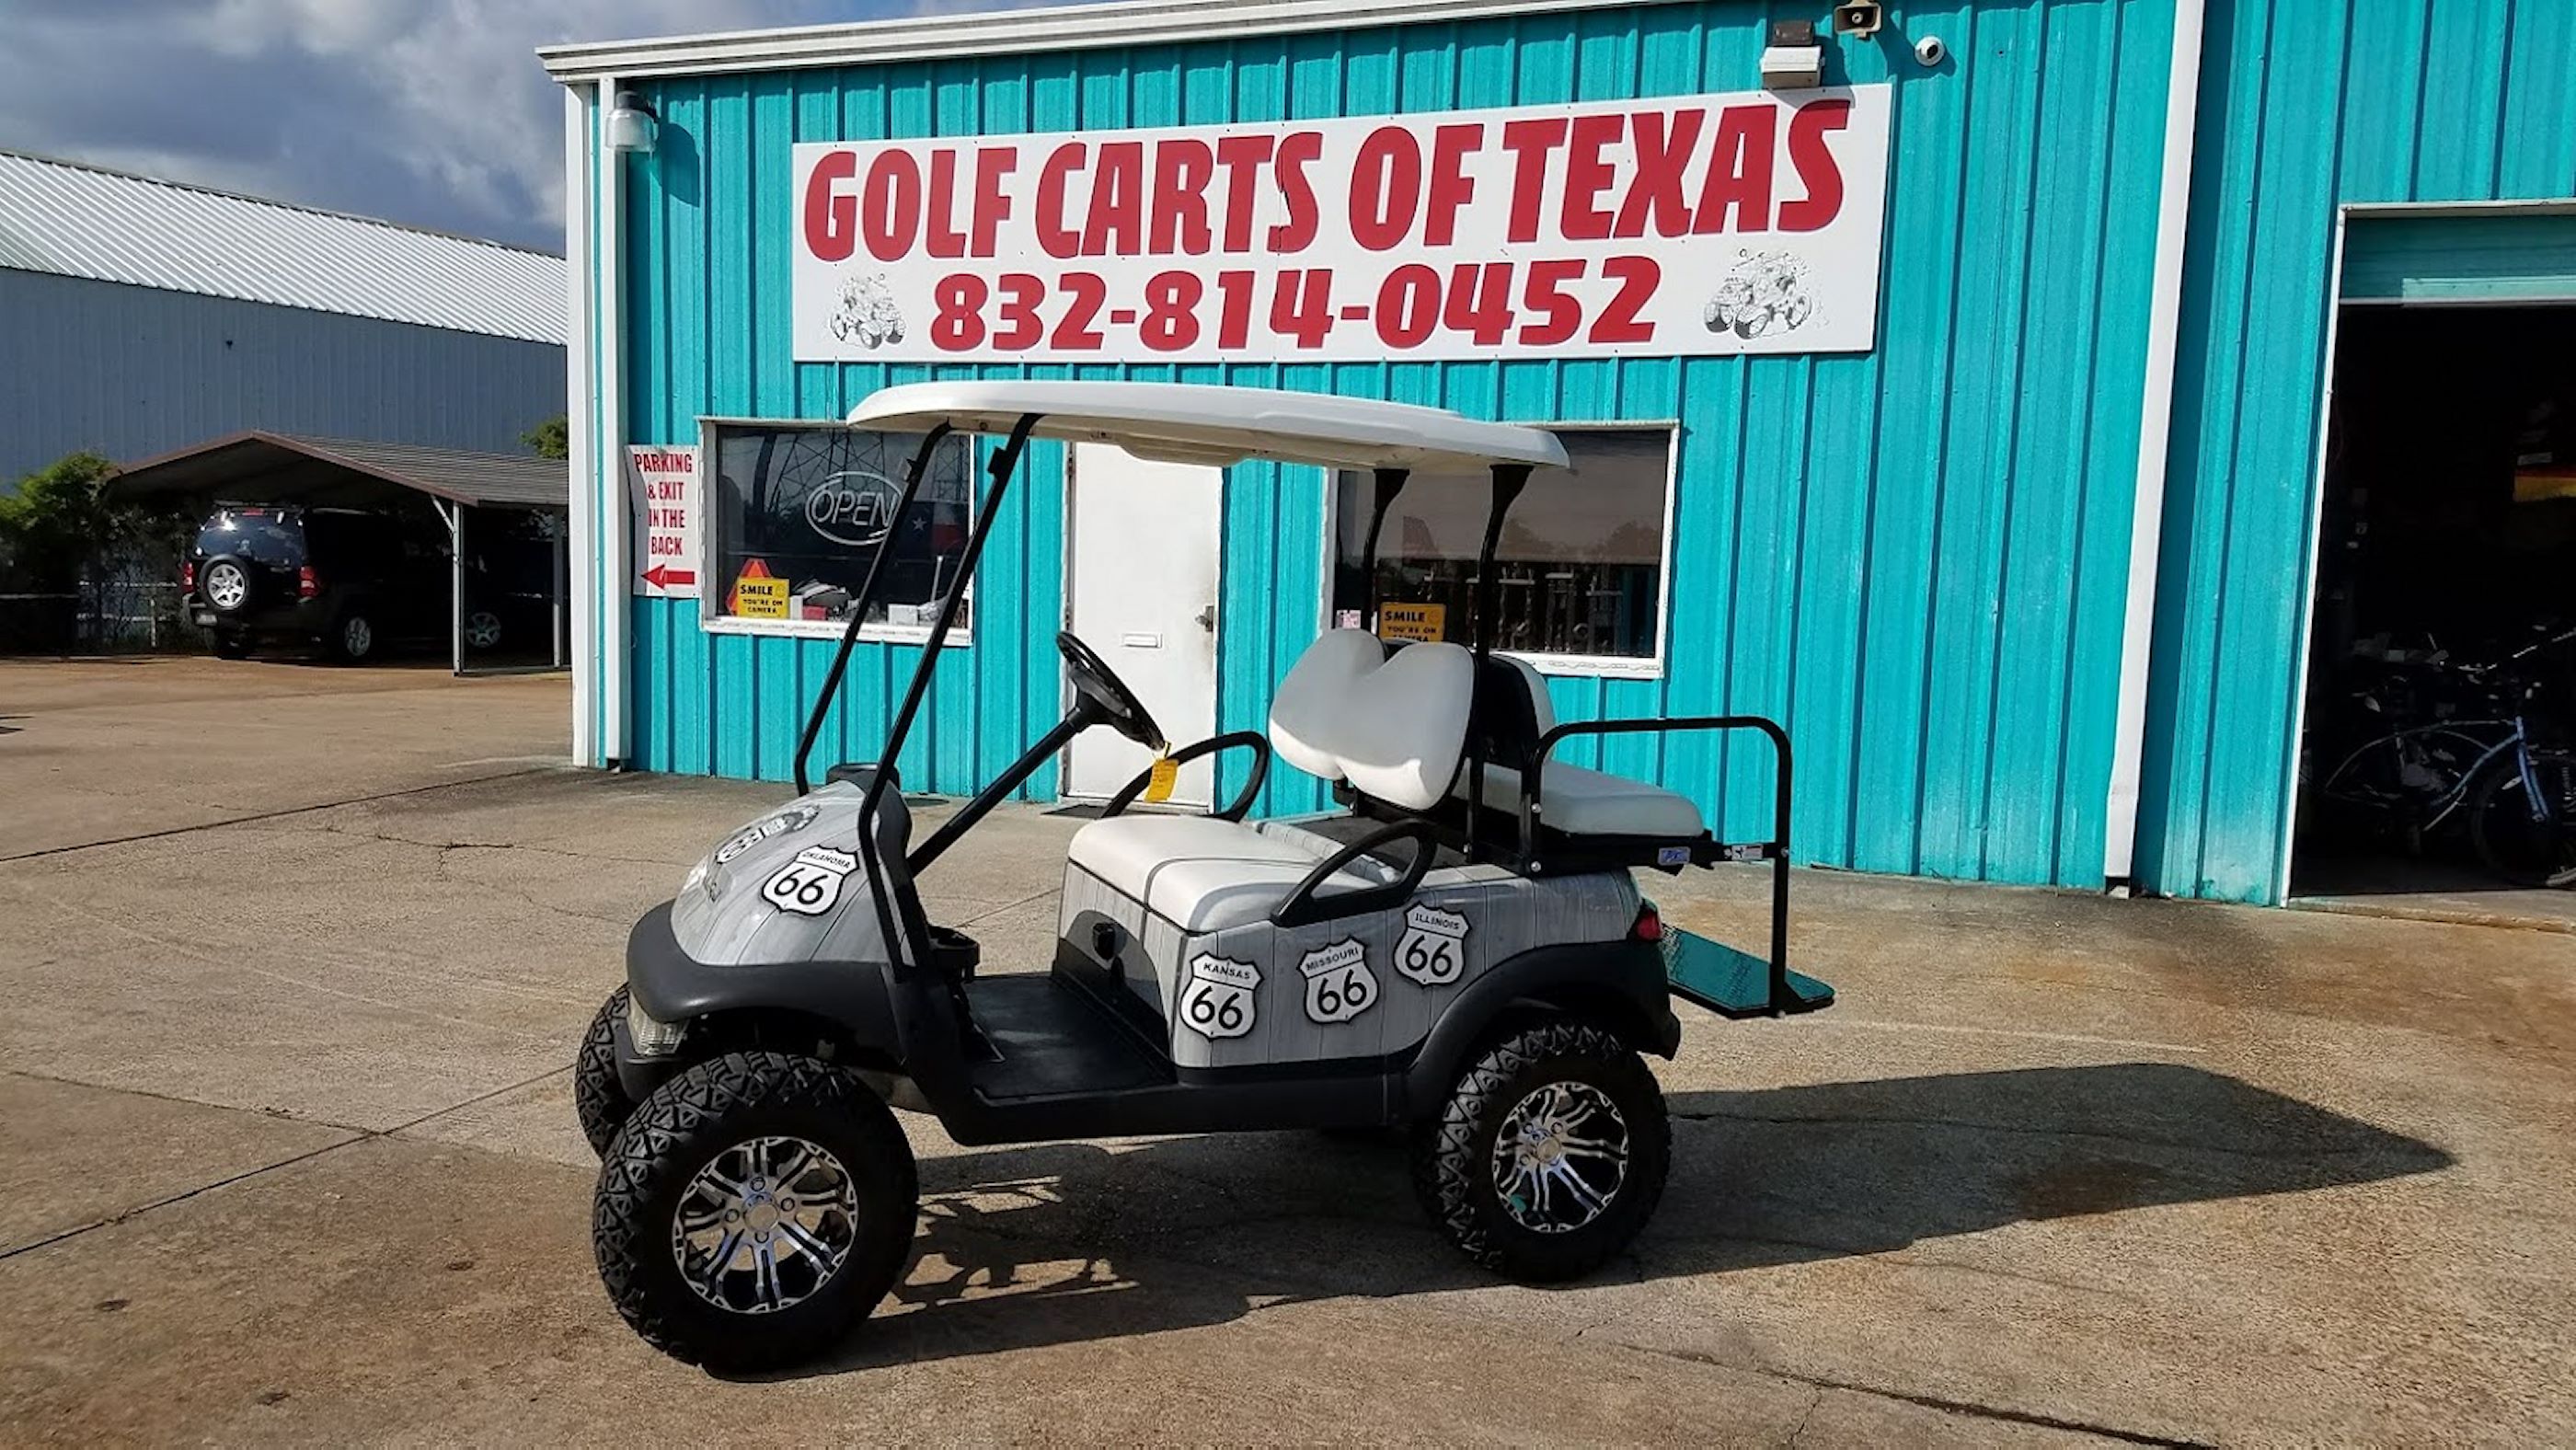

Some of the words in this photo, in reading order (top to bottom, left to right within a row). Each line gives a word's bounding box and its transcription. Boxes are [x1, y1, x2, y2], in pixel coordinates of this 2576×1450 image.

[804, 146, 1017, 262] GOLF
[1034, 132, 1323, 259] CARTS
[1349, 123, 1484, 250] OF
[1502, 99, 1850, 244] TEXAS
[930, 256, 1662, 352] 832-814-0452
[633, 454, 693, 473] PARKING
[648, 483, 657, 500] &
[659, 481, 684, 501] EXIT
[661, 508, 685, 528] THE
[811, 489, 898, 527] OPEN
[651, 536, 683, 555] BACK
[740, 584, 773, 595] SMILE
[1384, 611, 1425, 623] SMILE
[1423, 626, 1436, 634] ON
[802, 851, 850, 869] OKLAHOMA
[774, 868, 828, 904] 66
[1415, 912, 1459, 929] ILLINOIS
[1305, 947, 1359, 971] MISSOURI
[1406, 934, 1452, 977] 66
[1203, 962, 1250, 980] KANSAS
[1317, 969, 1367, 1016] 66
[1191, 985, 1243, 1030] 66
